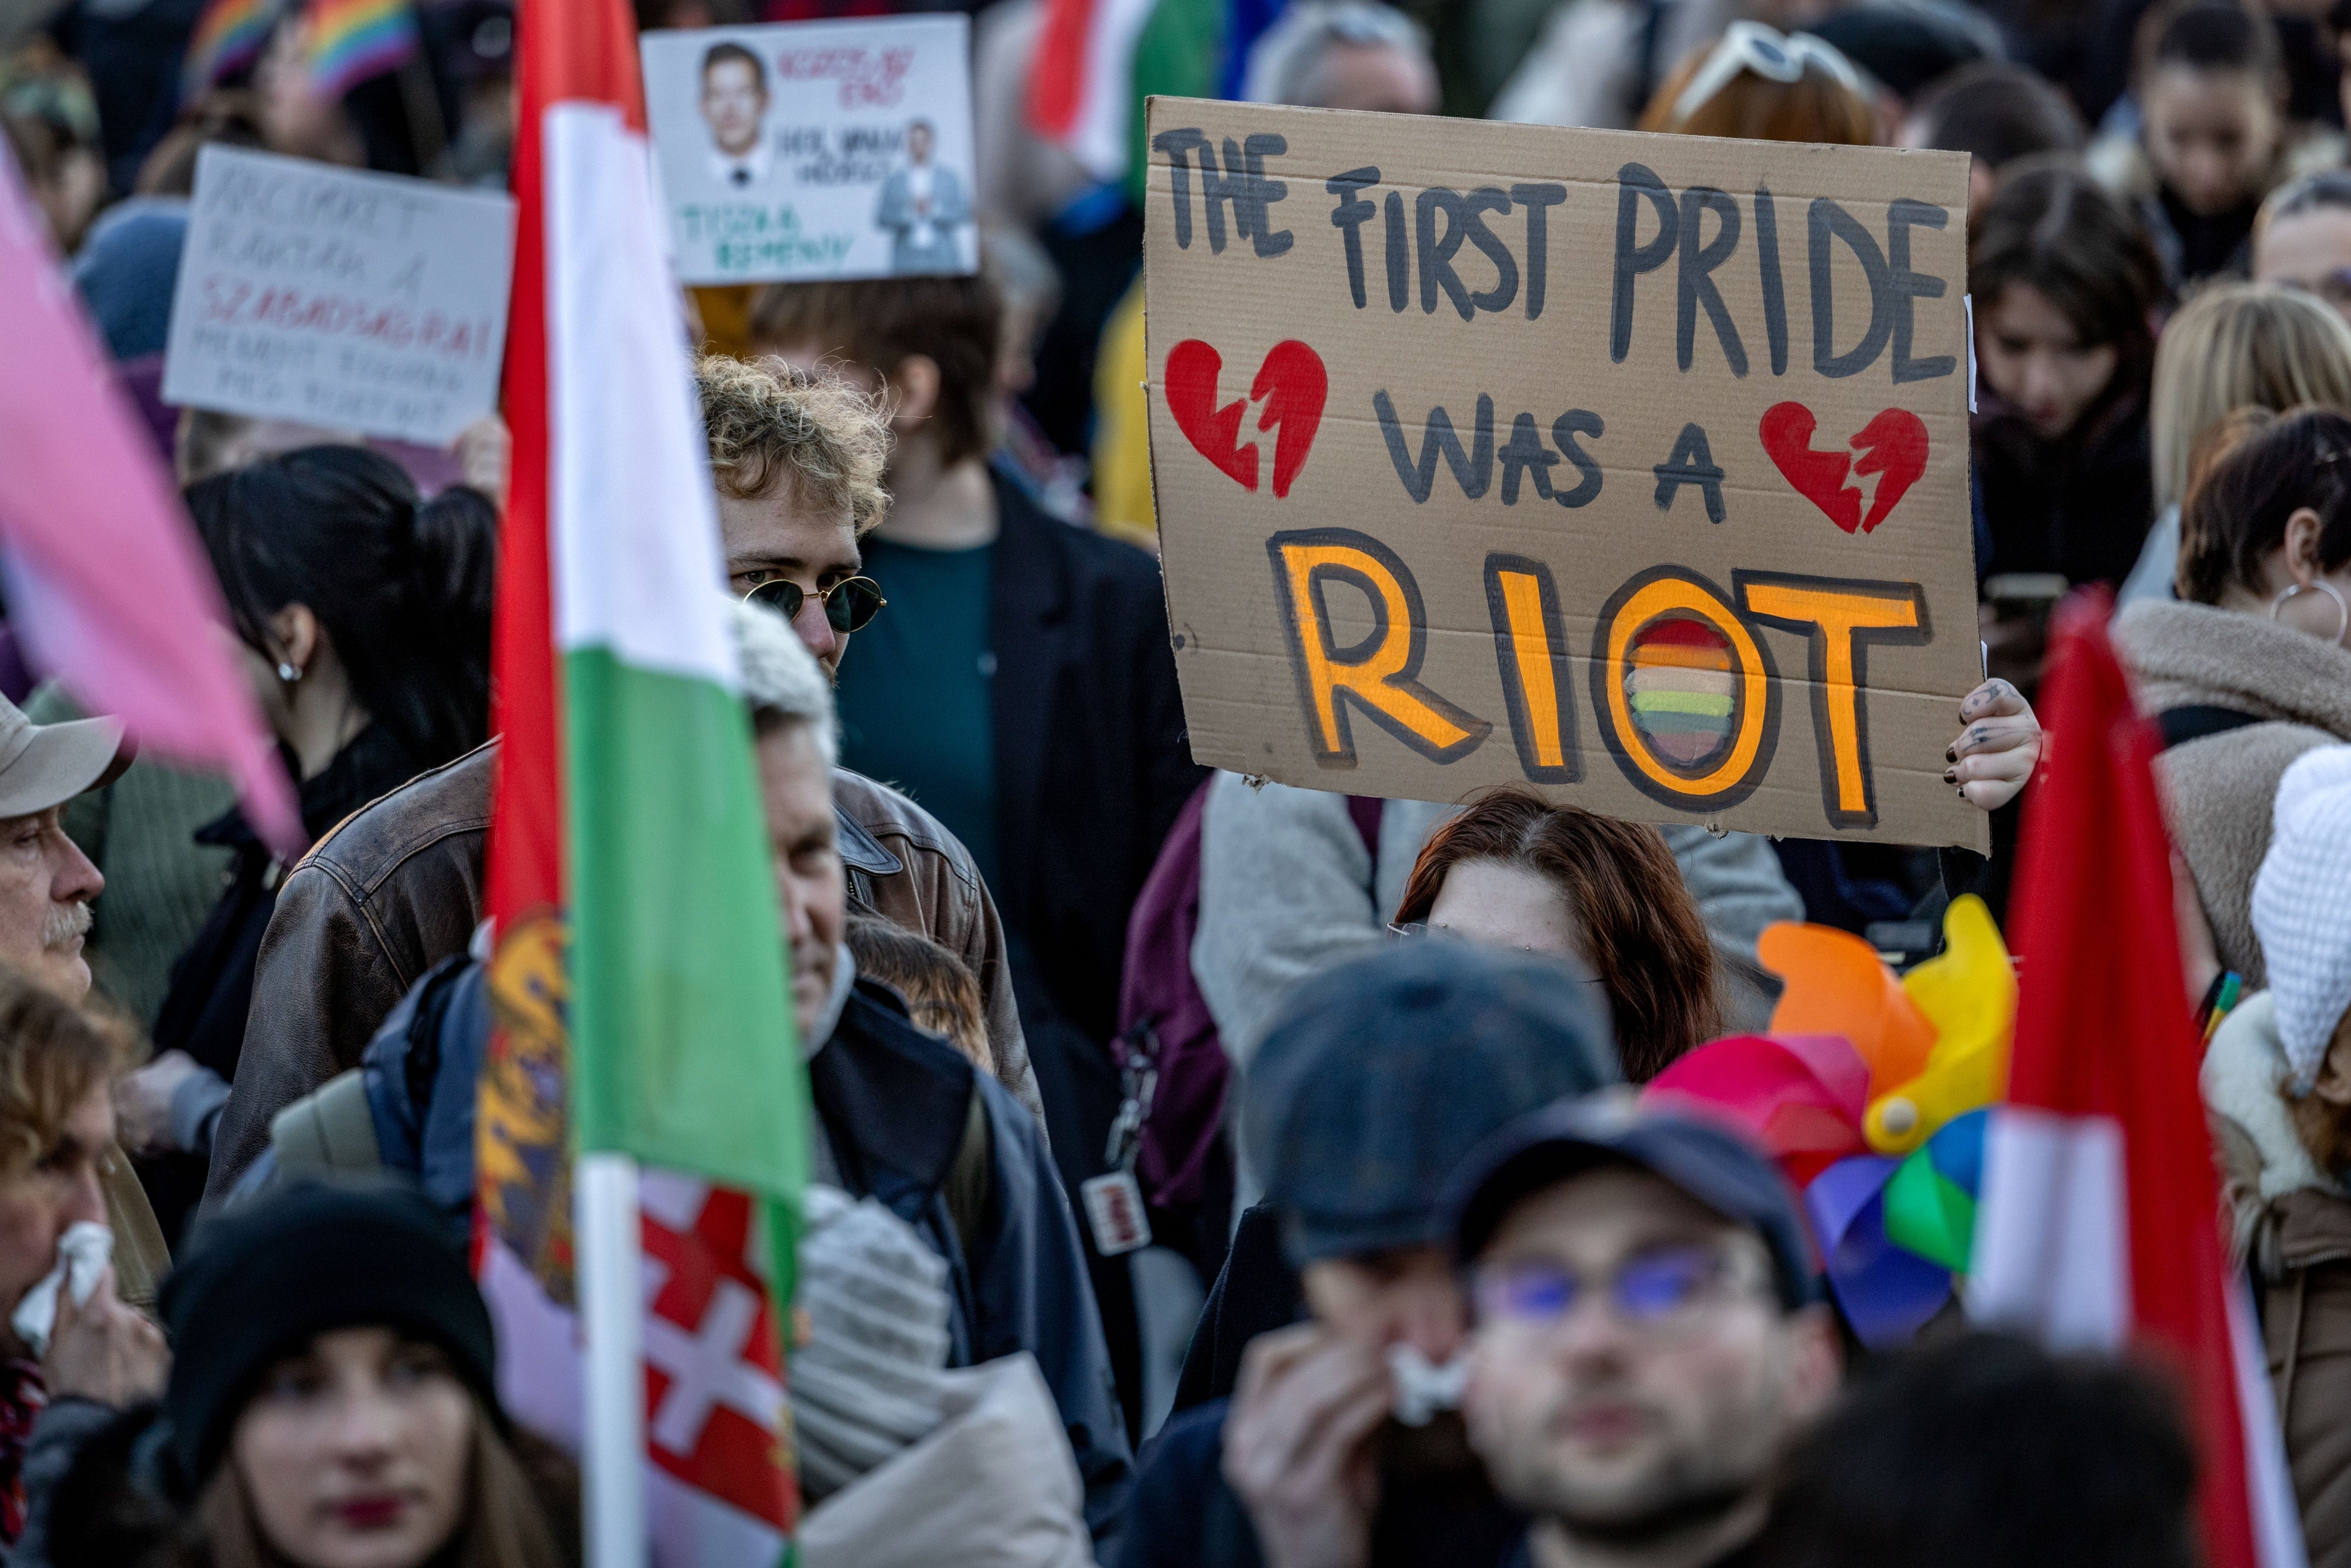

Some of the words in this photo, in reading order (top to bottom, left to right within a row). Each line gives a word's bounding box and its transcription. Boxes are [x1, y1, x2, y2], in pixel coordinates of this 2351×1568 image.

[1152, 127, 1294, 257] THE
[1325, 165, 1568, 321] FIRST
[1609, 161, 1957, 384] PRIDE
[1372, 388, 1605, 508] WAS
[1652, 421, 1726, 524] A
[1266, 527, 1935, 830] RIOT
